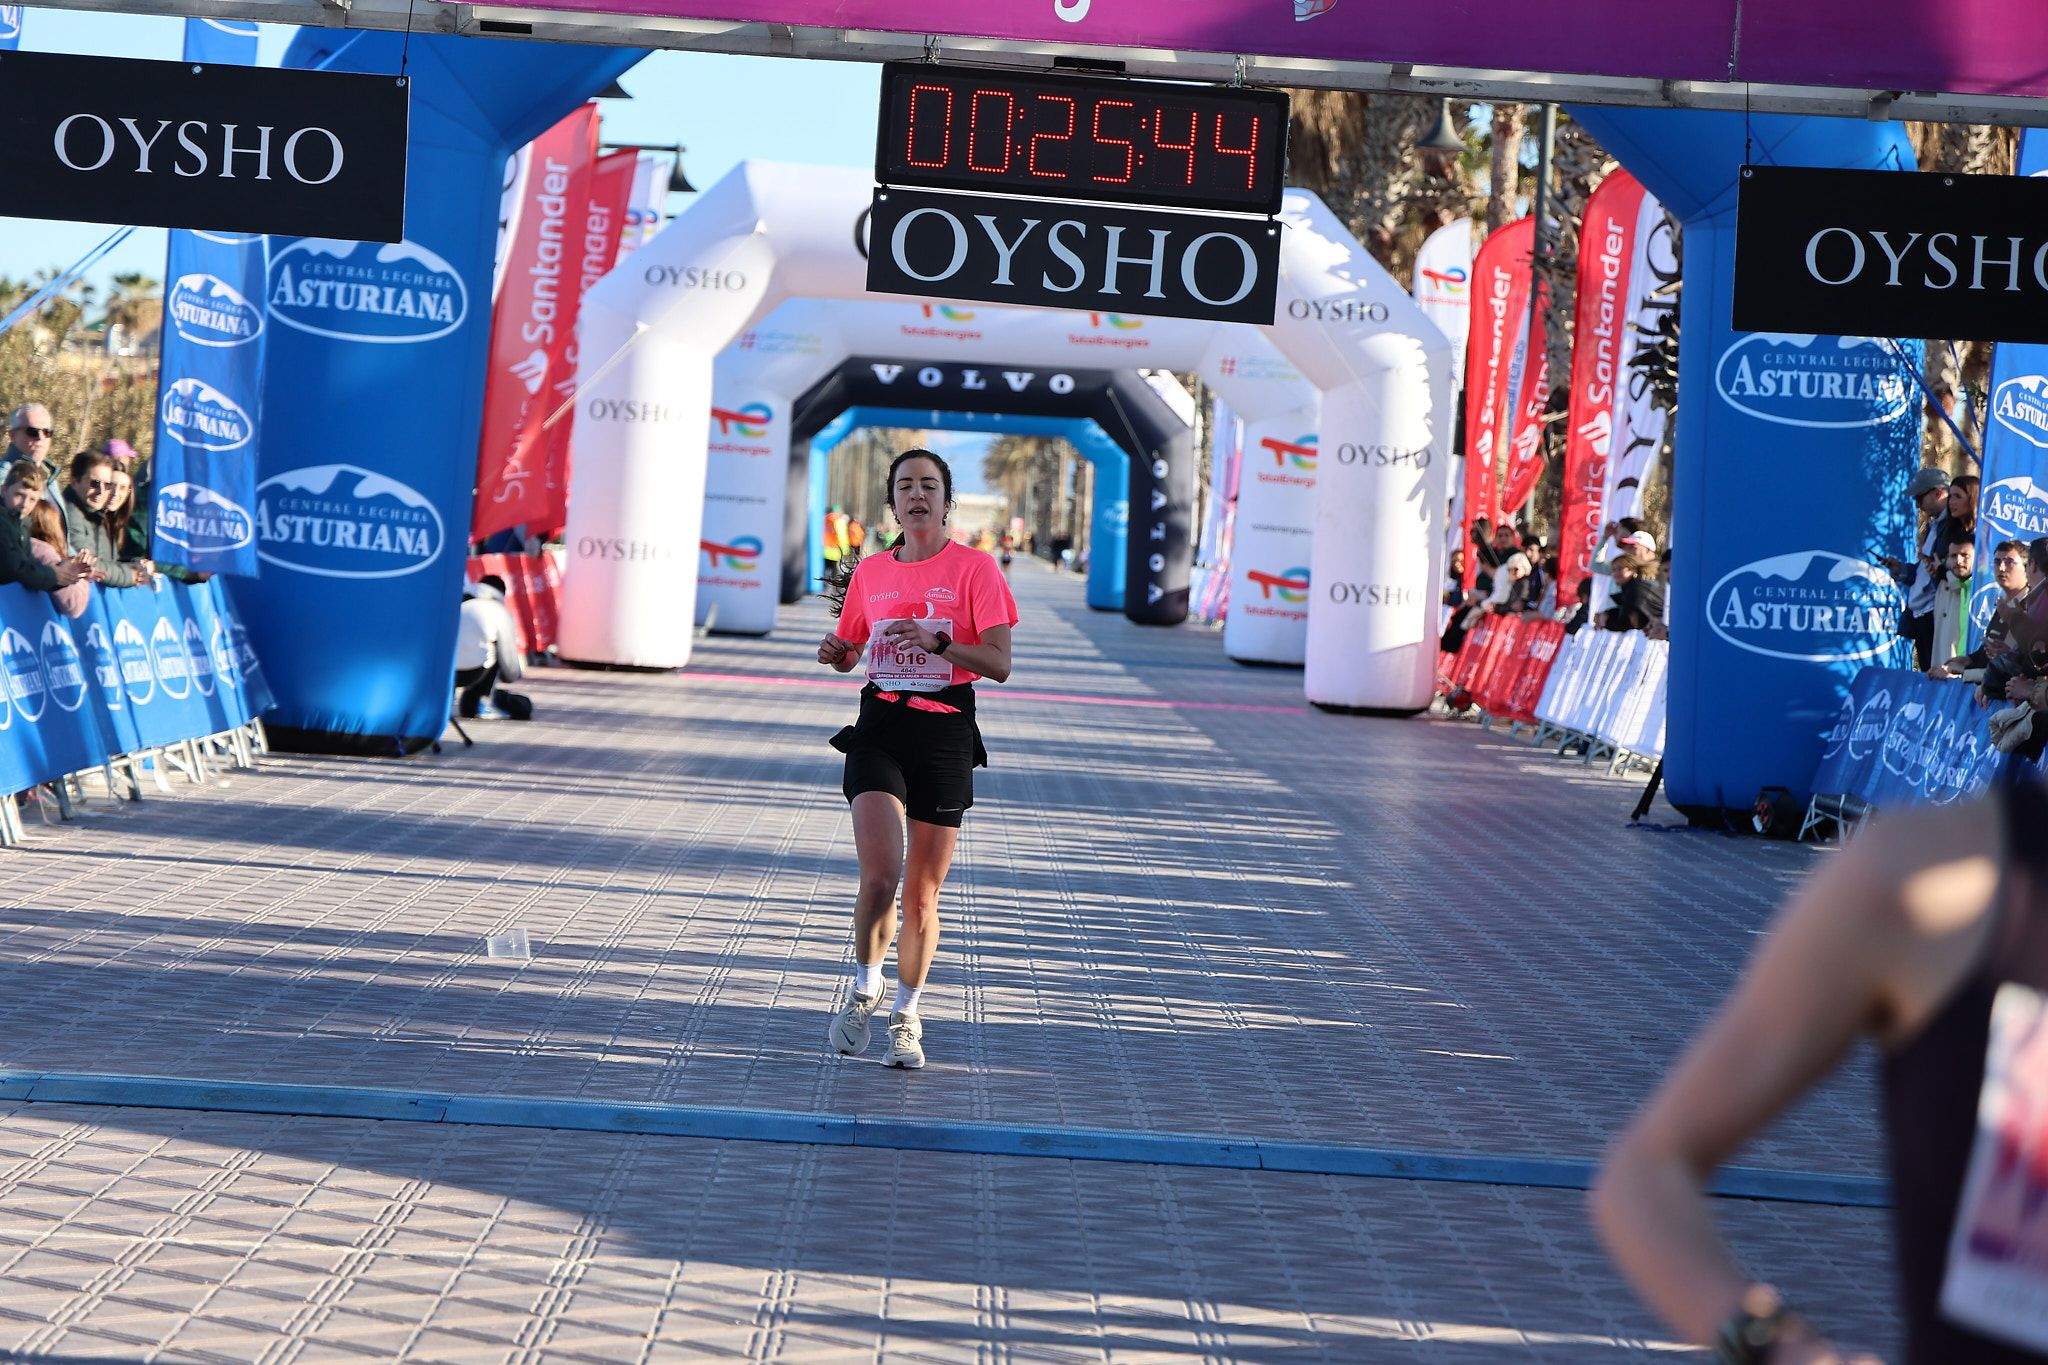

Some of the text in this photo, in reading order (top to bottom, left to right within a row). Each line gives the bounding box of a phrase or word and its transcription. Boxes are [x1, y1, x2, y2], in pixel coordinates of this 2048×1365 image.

[54, 113, 344, 185] OYSHO
[906, 84, 1260, 190] 00:25:44
[302, 262, 375, 280] CENTRAL
[521, 156, 569, 345] Santander
[891, 207, 1258, 306] OYSHO
[1805, 227, 2048, 291] OYSH
[272, 263, 454, 324] ASTURIANA
[645, 264, 746, 292] OYSHO
[176, 301, 252, 337] STURIANA
[1289, 298, 1389, 324] OYSHO
[1587, 217, 1624, 405] Santander
[870, 363, 1075, 395] VOLVO
[1728, 354, 1906, 402] ASTURIANA
[1763, 353, 1900, 369] CENTRAL LECHER
[1337, 443, 1431, 469] OYSHO
[156, 500, 245, 541] ASTRIANA
[256, 498, 430, 557] ASTURIANA
[278, 497, 427, 522] CENTRAL LECHERA
[1147, 458, 1169, 606] VOLVO
[869, 590, 899, 603] OYSHO
[1719, 587, 1897, 633] ASTURIANA
[1753, 586, 1827, 600] CENTRAL
[895, 652, 927, 666] 016
